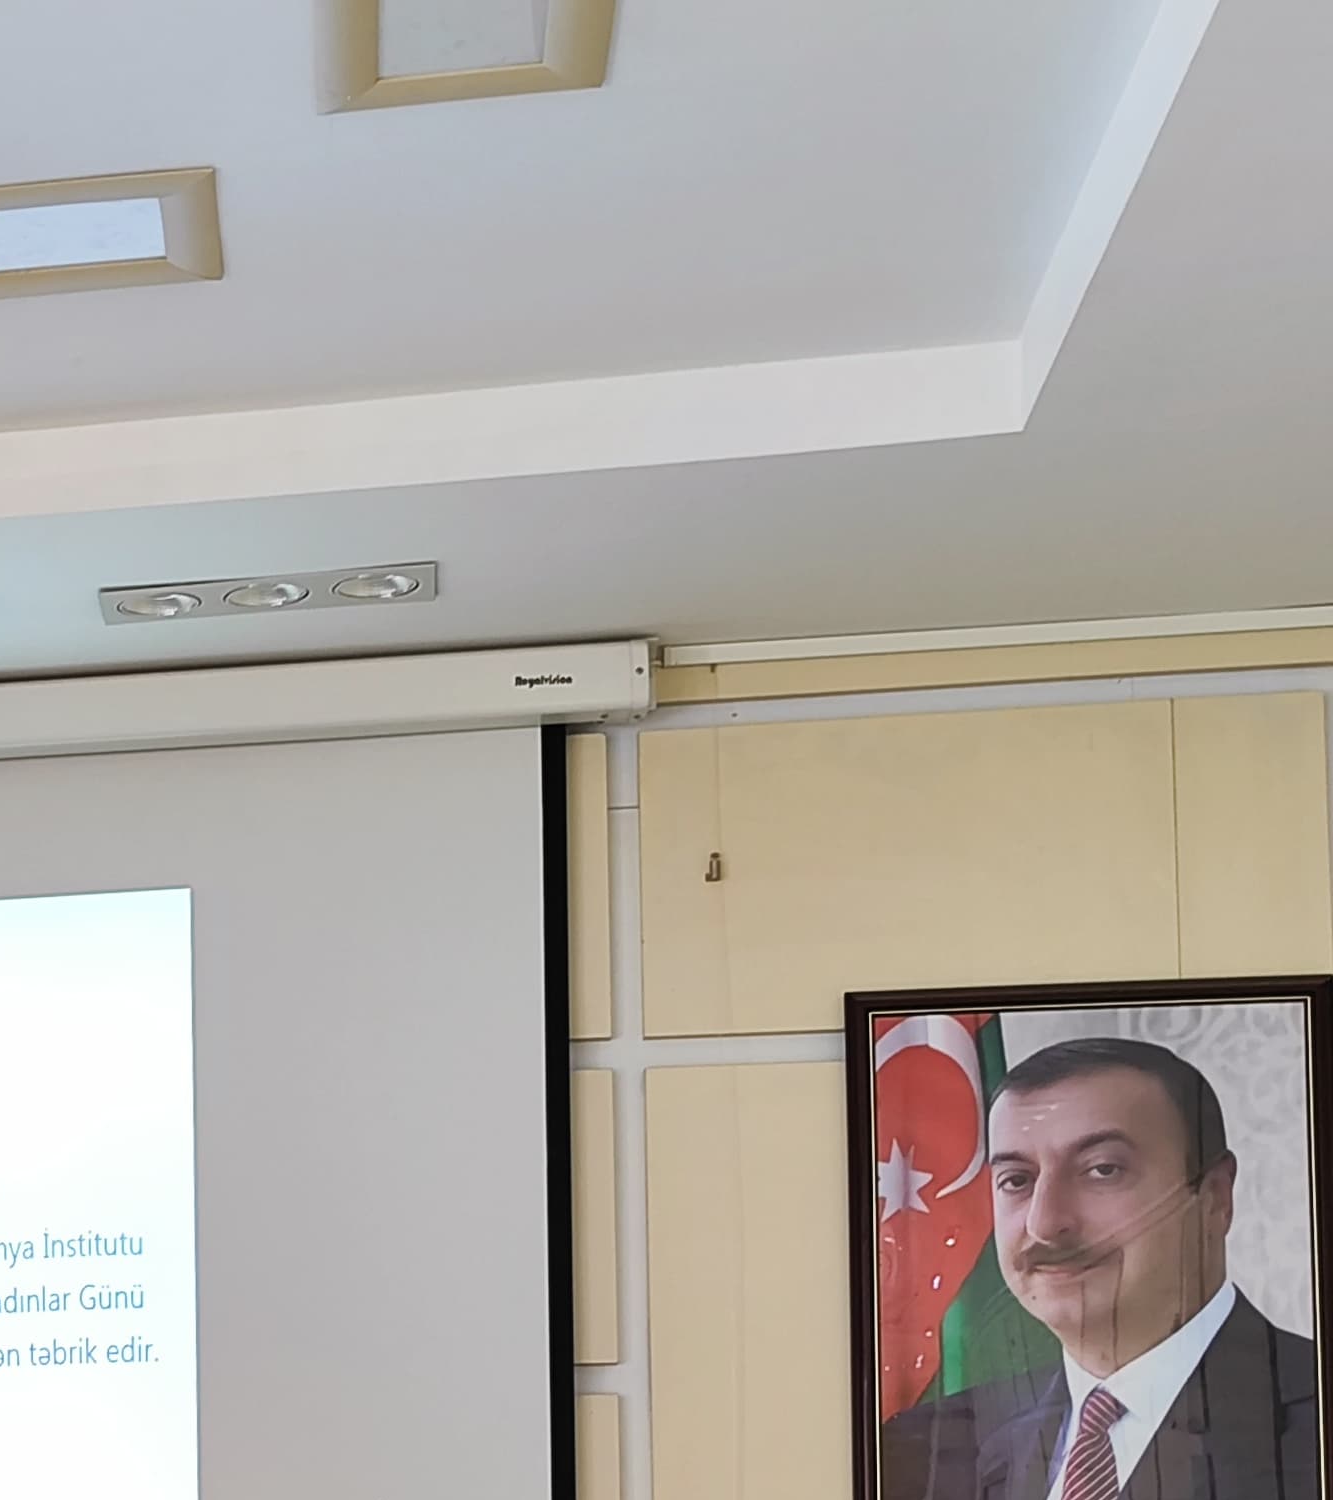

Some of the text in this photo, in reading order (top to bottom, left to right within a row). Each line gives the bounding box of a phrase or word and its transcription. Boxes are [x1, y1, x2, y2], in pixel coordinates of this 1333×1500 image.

[42, 1227, 144, 1260] İnstitutu
[78, 1283, 147, 1312] Günü
[28, 1336, 98, 1367] təbrik
[105, 1335, 161, 1366] edir.
